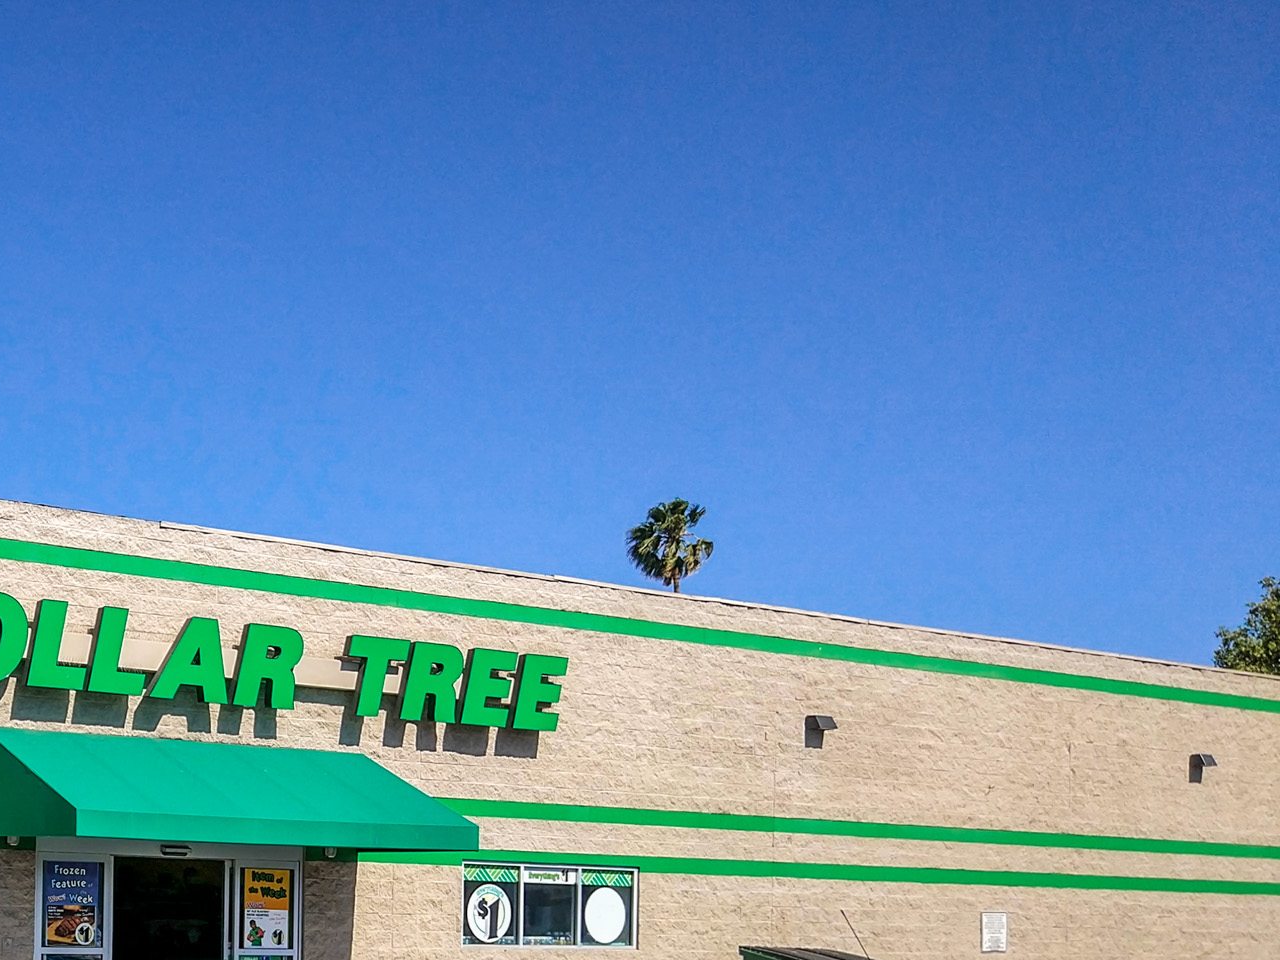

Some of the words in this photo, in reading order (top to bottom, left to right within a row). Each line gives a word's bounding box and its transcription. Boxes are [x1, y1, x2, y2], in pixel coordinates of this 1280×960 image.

[345, 634, 569, 732] TREE
[54, 864, 86, 875] Frozen
[251, 870, 274, 883] Item
[51, 879, 87, 888] Feature
[69, 894, 93, 904] Week
[260, 886, 287, 899] Week
[477, 897, 500, 940] $1
